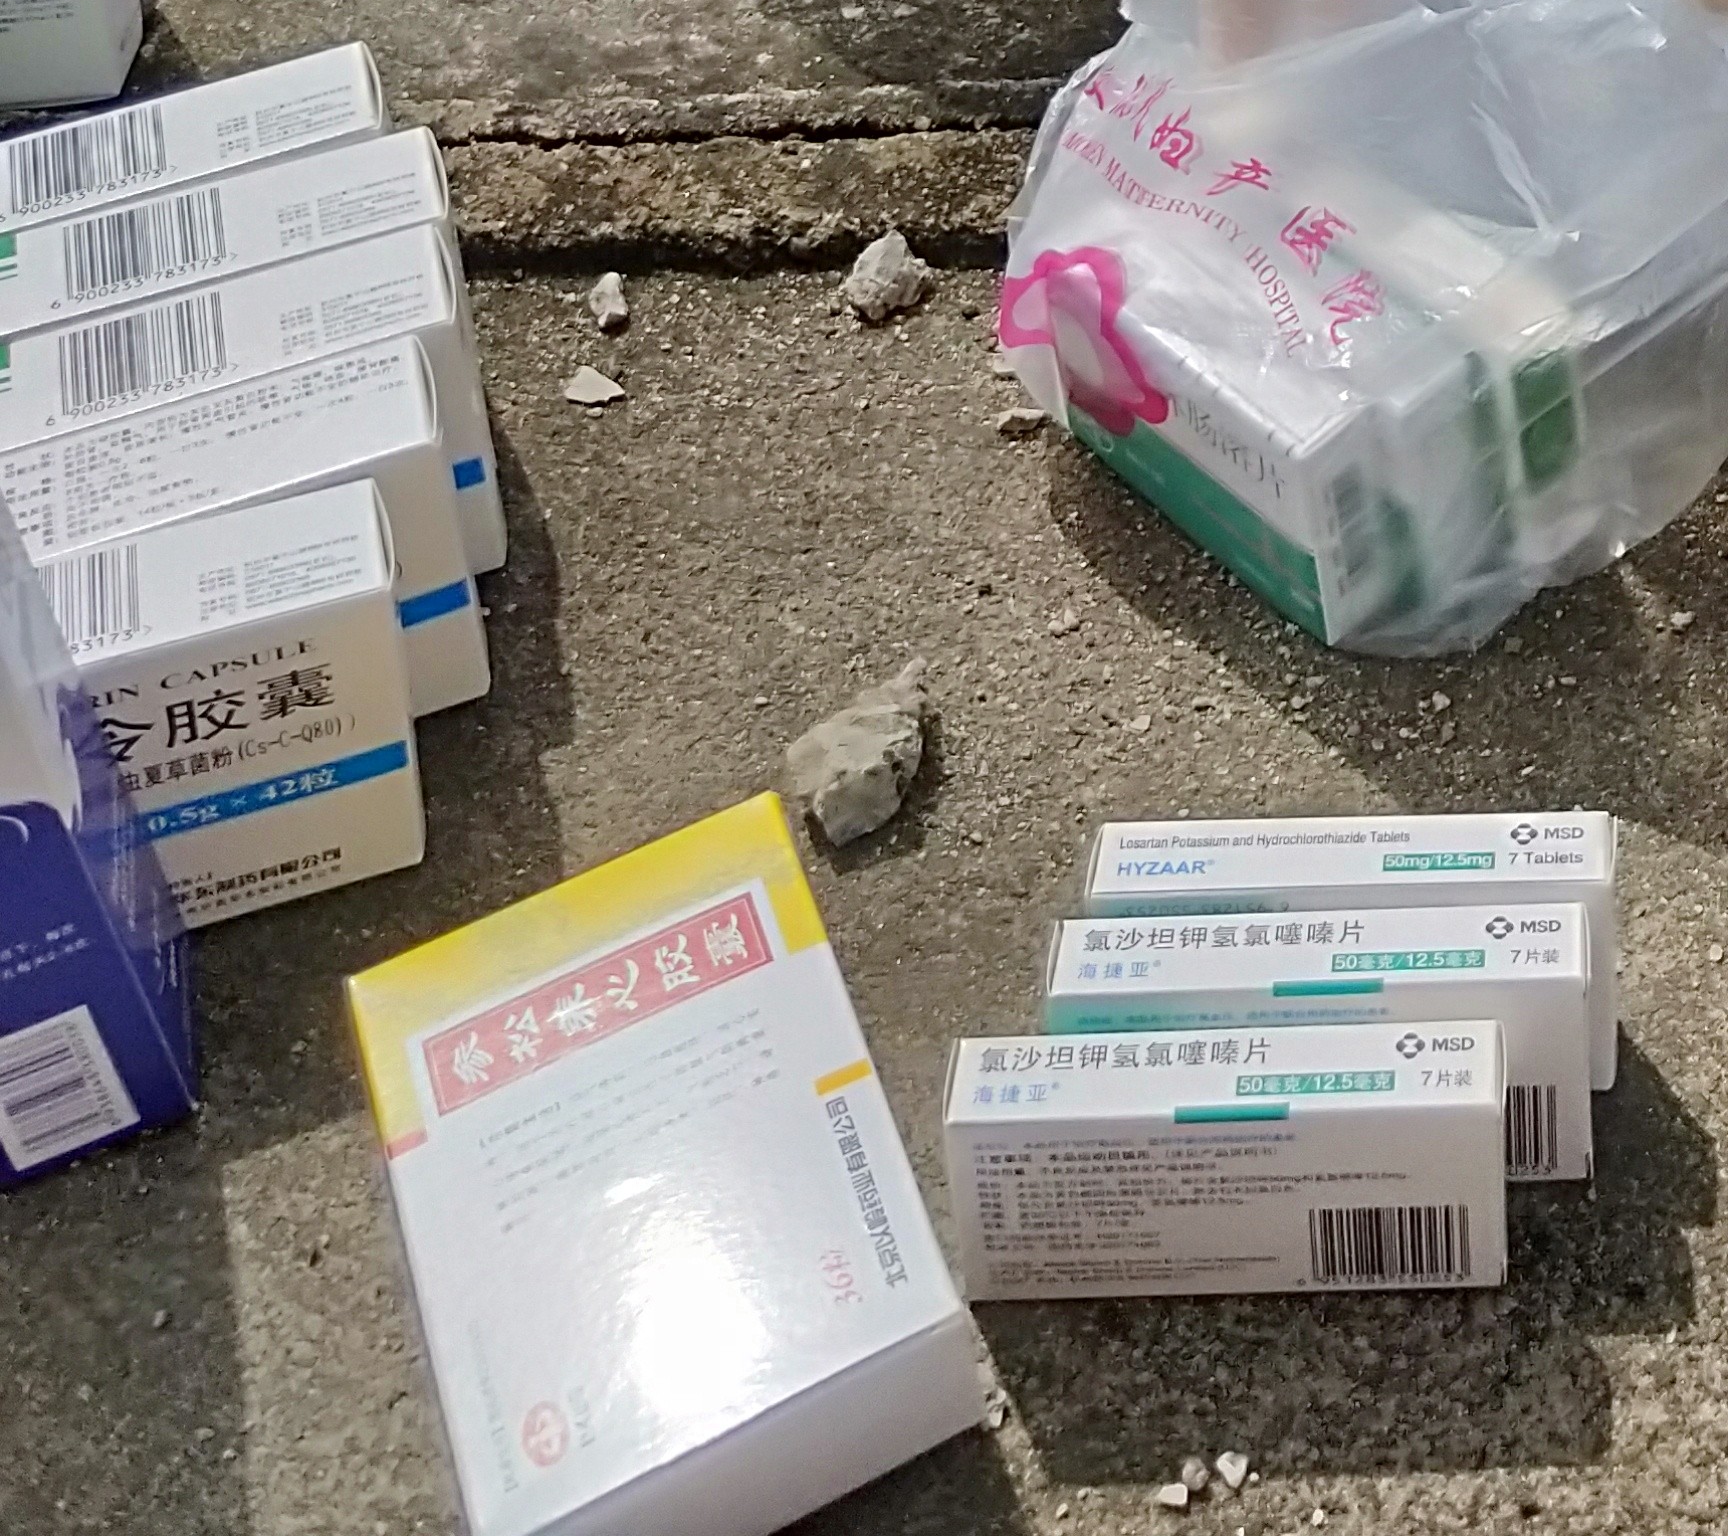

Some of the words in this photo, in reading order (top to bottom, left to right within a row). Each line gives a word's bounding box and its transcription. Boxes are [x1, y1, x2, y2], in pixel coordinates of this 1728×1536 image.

[1244, 240, 1309, 357] HOSPITAL
[160, 637, 318, 689] CAPSULE
[101, 663, 335, 767] 令胶囊
[149, 803, 220, 831] 0.5g
[259, 768, 338, 802] 42粒
[1119, 836, 1168, 850] Losartan
[1171, 835, 1230, 849] Potassium
[1232, 835, 1253, 847] and
[1256, 830, 1367, 849] Hydrochlorothiazide
[1370, 830, 1410, 843] Tablets
[1543, 826, 1585, 840] MSD
[1384, 853, 1494, 870] 50mg/12.5mg
[1508, 852, 1519, 865] 7
[1523, 851, 1584, 865] Tablets
[1082, 918, 1365, 953] 氯沙坦钾氢氯噻嗪片
[1519, 919, 1562, 934] MSD
[1333, 950, 1483, 971] 50毫克/12.5毫克
[1510, 947, 1561, 965] 7片装
[980, 1037, 1273, 1074] 氯沙坦钾氢氯噻嗪片
[1431, 1035, 1475, 1053] MSD
[1238, 1072, 1394, 1096] 50毫克/12.5毫克
[1420, 1068, 1473, 1089] 7片装
[825, 1095, 910, 1288] 北京以岭药业有限公司
